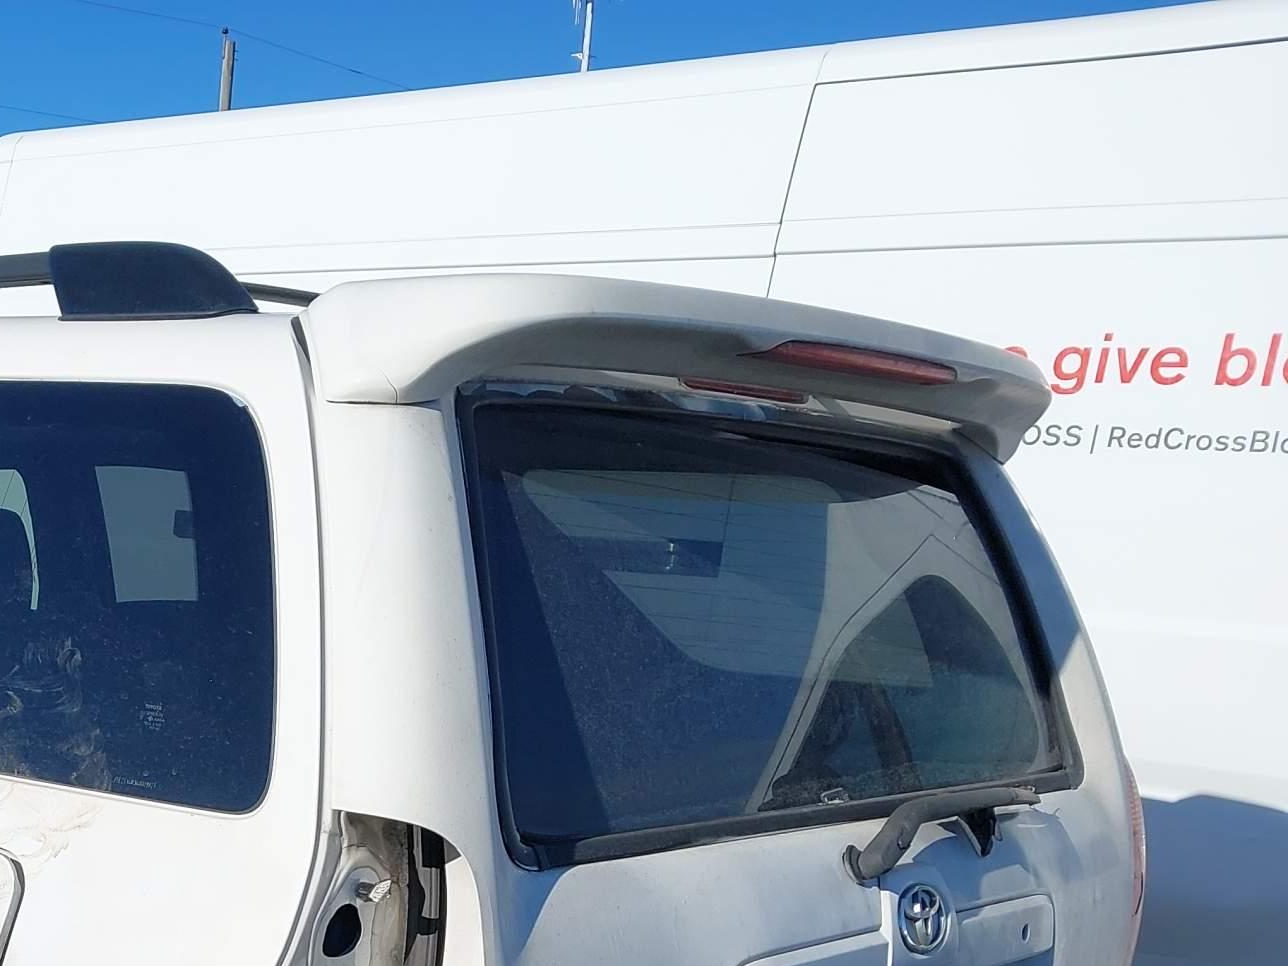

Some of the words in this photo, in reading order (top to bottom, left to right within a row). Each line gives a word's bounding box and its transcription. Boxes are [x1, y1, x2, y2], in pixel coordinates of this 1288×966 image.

[1050, 333, 1189, 395] give
[1214, 332, 1288, 387] bl
[1022, 424, 1084, 447] OSS
